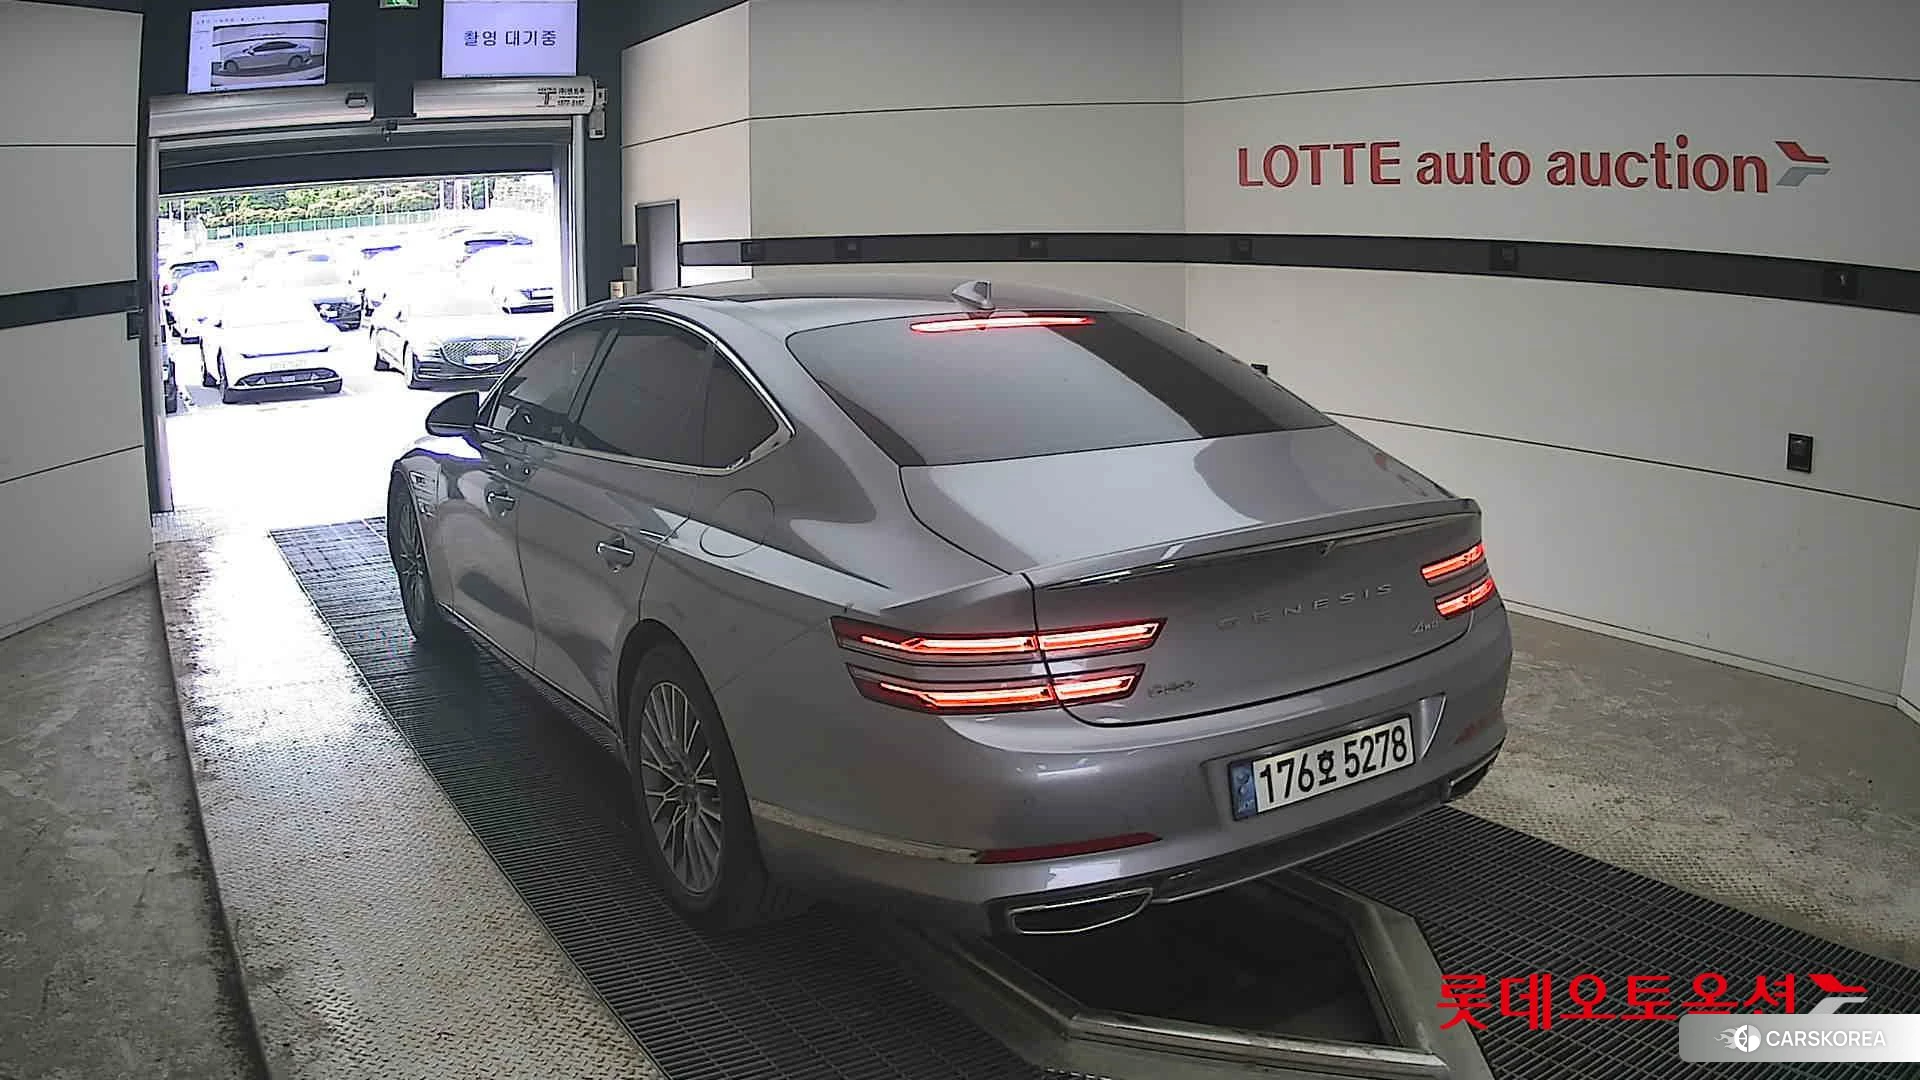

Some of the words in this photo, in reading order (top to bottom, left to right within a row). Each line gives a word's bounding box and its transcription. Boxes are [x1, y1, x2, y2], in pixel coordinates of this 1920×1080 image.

[463, 30, 497, 47] 촬영
[505, 29, 557, 47] 대기중
[1237, 141, 1401, 188] LOTTE
[1416, 141, 1531, 187] auto
[1546, 134, 1769, 194] auction
[1216, 583, 1392, 633] GENESIS
[1260, 749, 1337, 804] 176호
[1343, 725, 1408, 778] 5278
